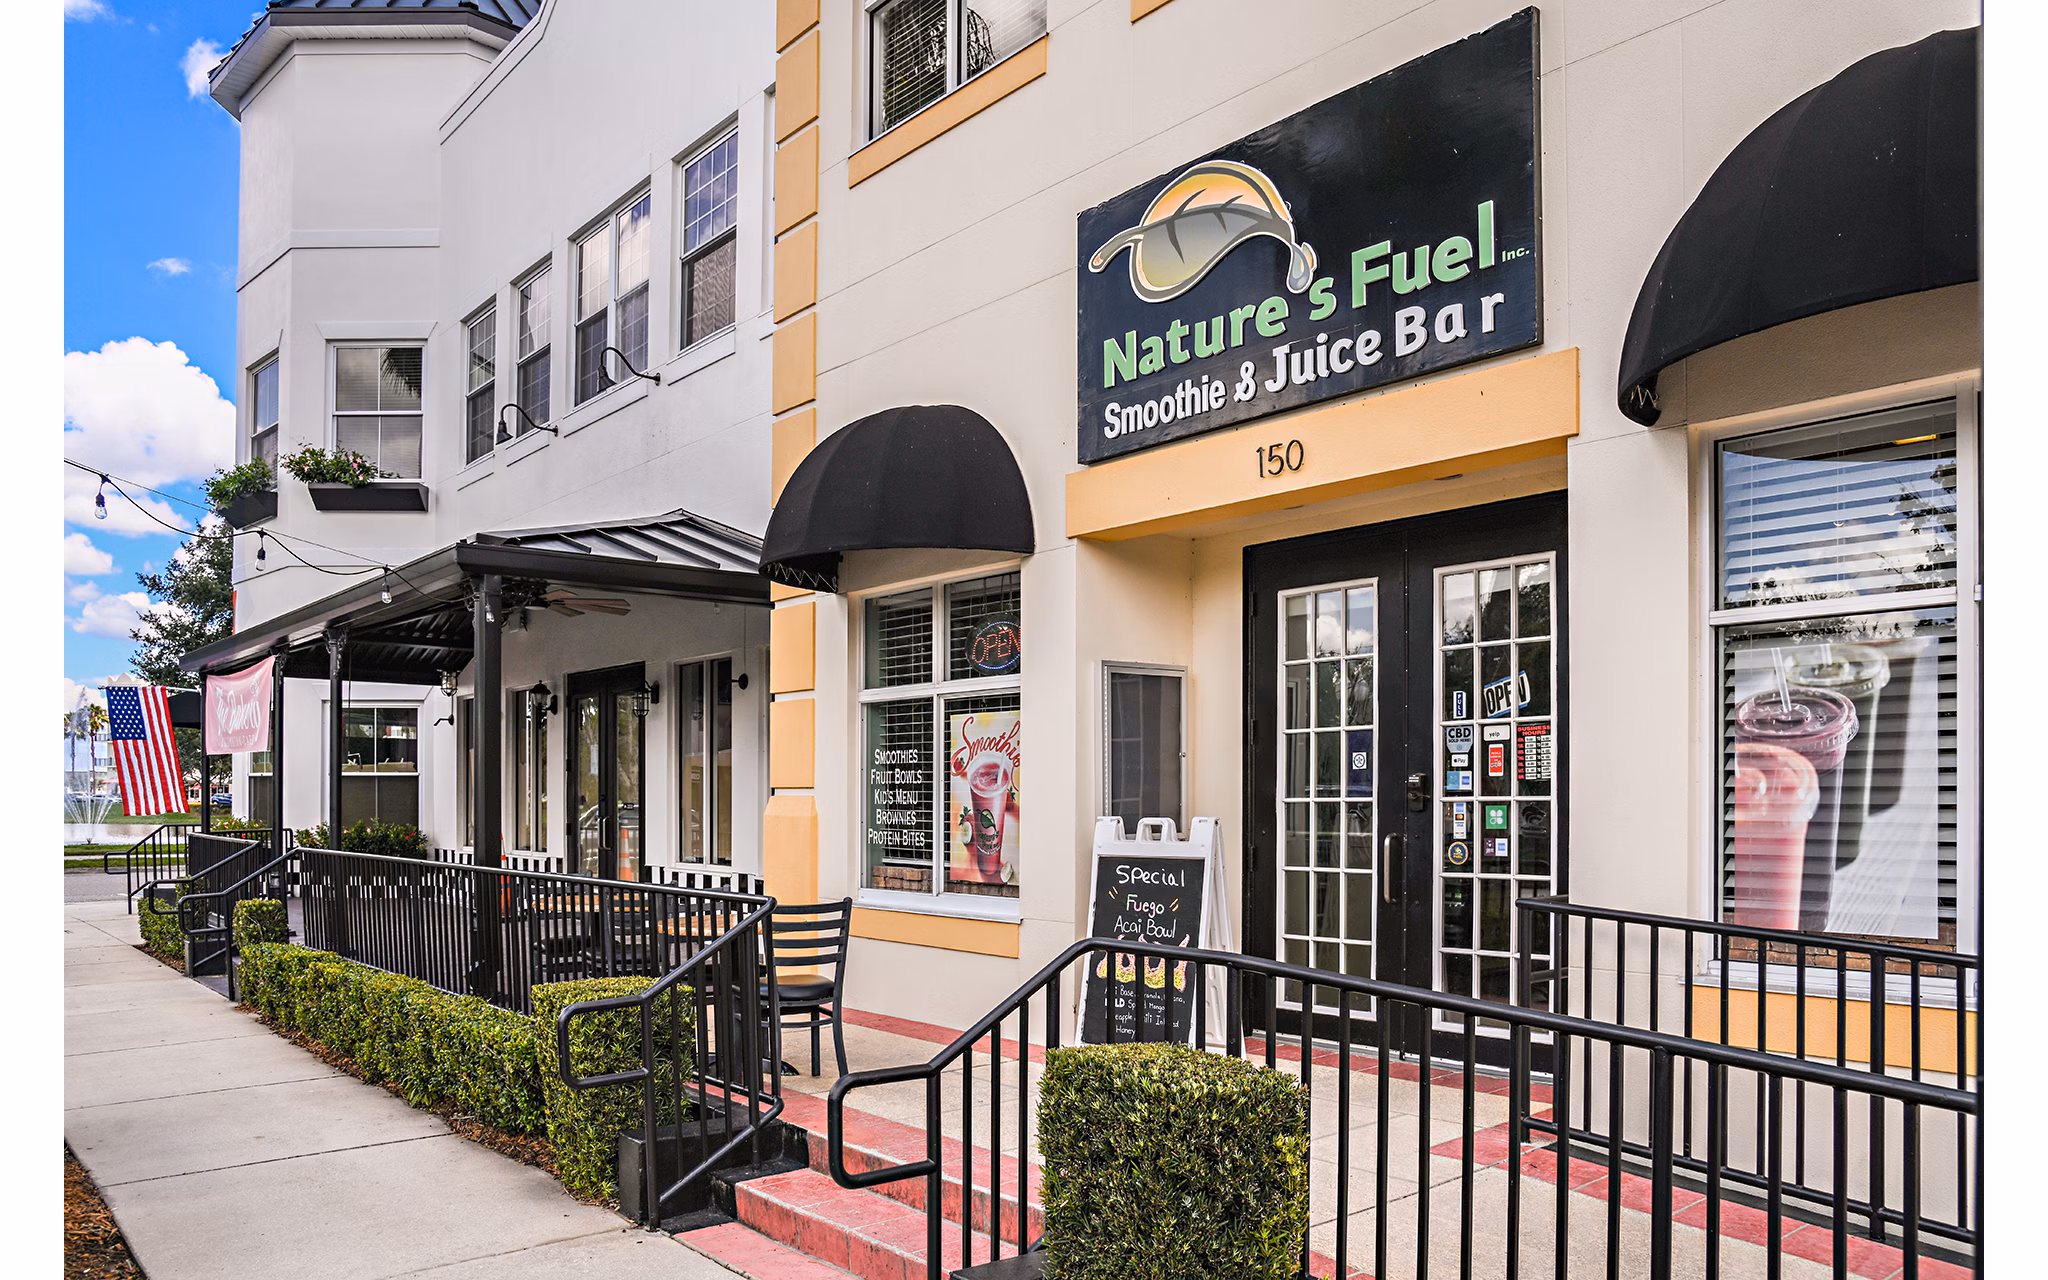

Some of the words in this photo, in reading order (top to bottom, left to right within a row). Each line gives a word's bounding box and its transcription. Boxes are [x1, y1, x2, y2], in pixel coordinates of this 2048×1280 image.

[1351, 199, 1495, 308] Fuel
[1501, 246, 1530, 263] Inc.
[1103, 373, 1227, 440] Smoothie
[1233, 361, 1256, 402] &
[1264, 328, 1383, 394] Juice
[1394, 292, 1505, 358] Bar
[1256, 439, 1305, 478] 150
[972, 625, 1021, 663] OPEN
[1448, 728, 1471, 738] CBD
[874, 748, 918, 765] SMOOTHIES
[870, 768, 892, 785] FRUIT
[894, 768, 922, 785] BOWLS
[874, 788, 893, 805] KID'S
[896, 788, 918, 805] MENU
[876, 808, 917, 826] BROWNIES
[868, 828, 900, 845] PROTEIN
[902, 829, 925, 846] BITES
[1126, 893, 1165, 918] Fuego
[1113, 915, 1142, 934] Acai
[1147, 919, 1177, 939] Bowl
[1149, 1002, 1166, 1014] Mango
[1115, 1024, 1136, 1039] Honey
